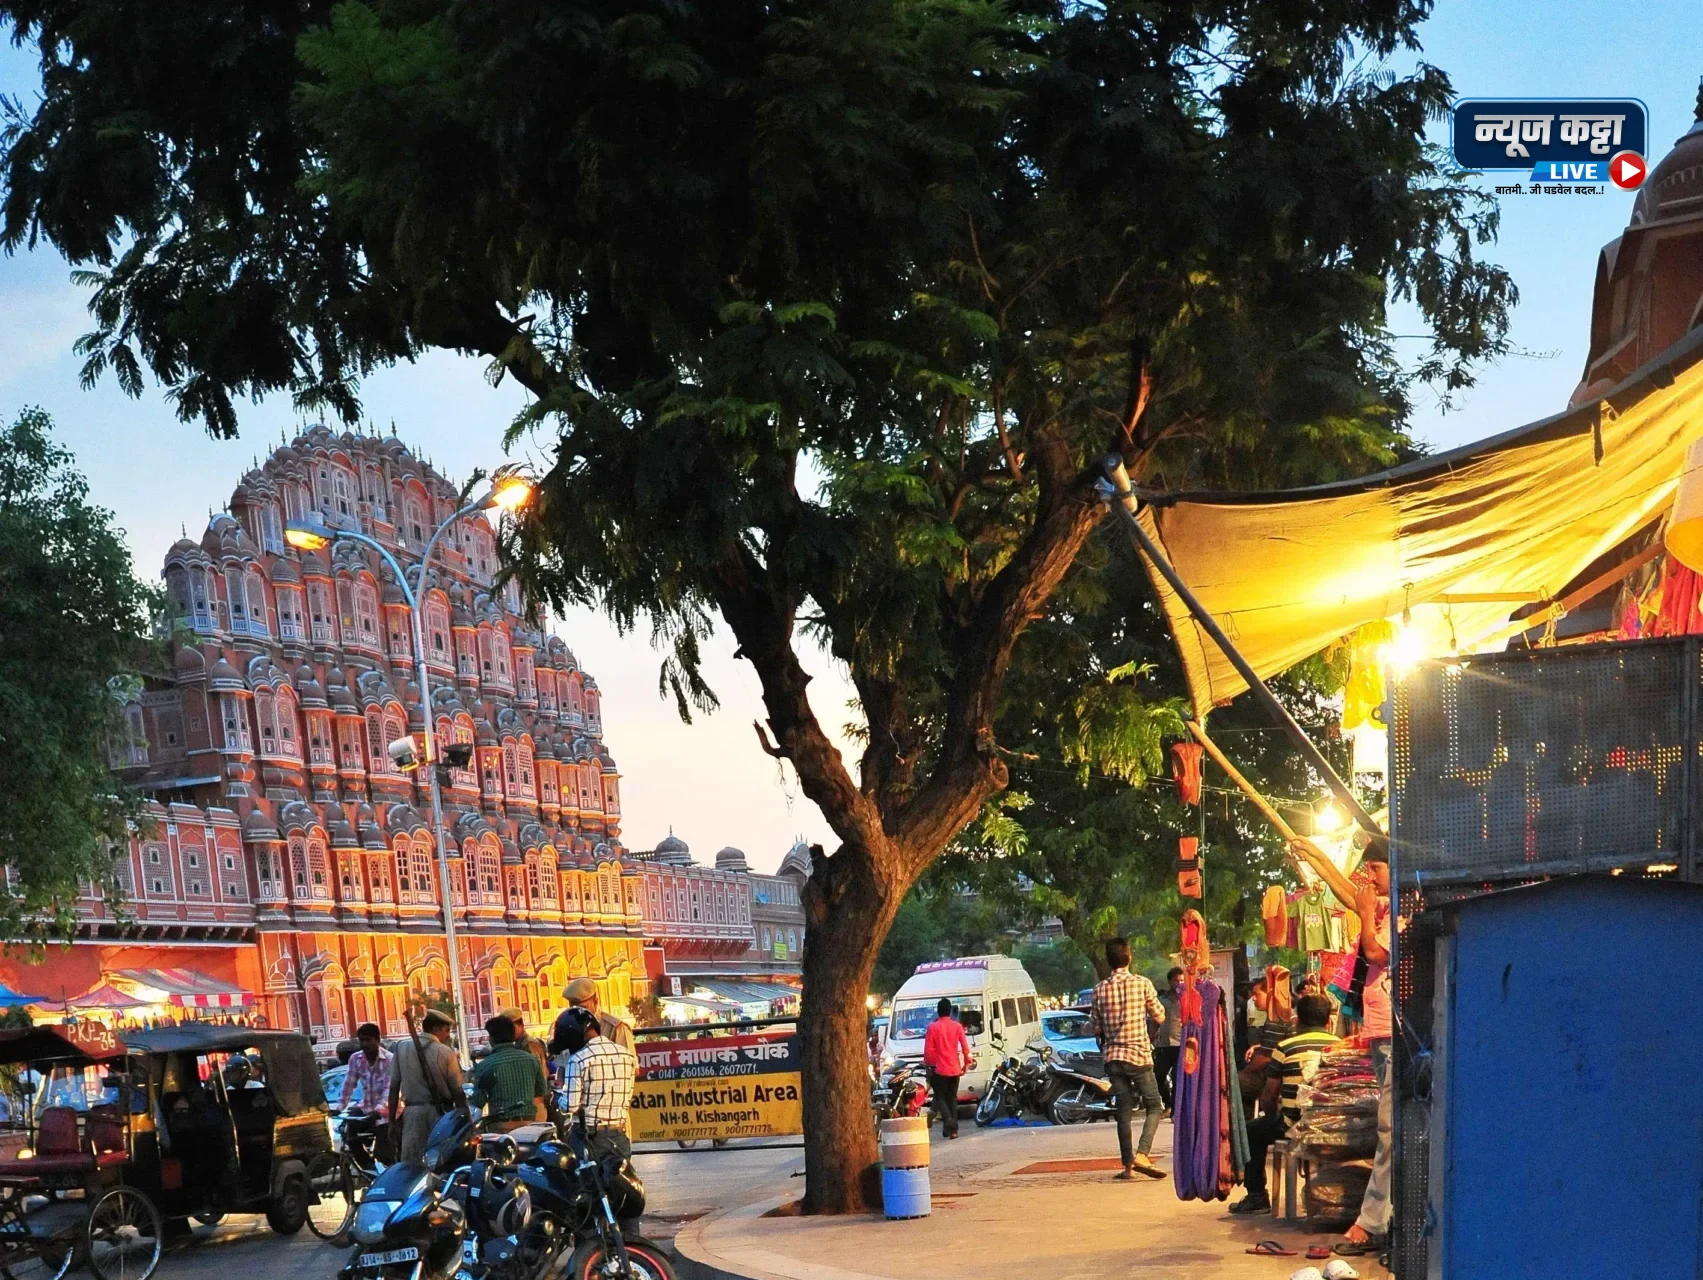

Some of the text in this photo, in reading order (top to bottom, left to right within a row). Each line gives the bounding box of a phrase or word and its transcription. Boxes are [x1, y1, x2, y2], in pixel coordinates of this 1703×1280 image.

[742, 1037, 789, 1061] चौक
[630, 1084, 798, 1109] atan Industrial Area
[696, 1108, 760, 1126] Kishangarh
